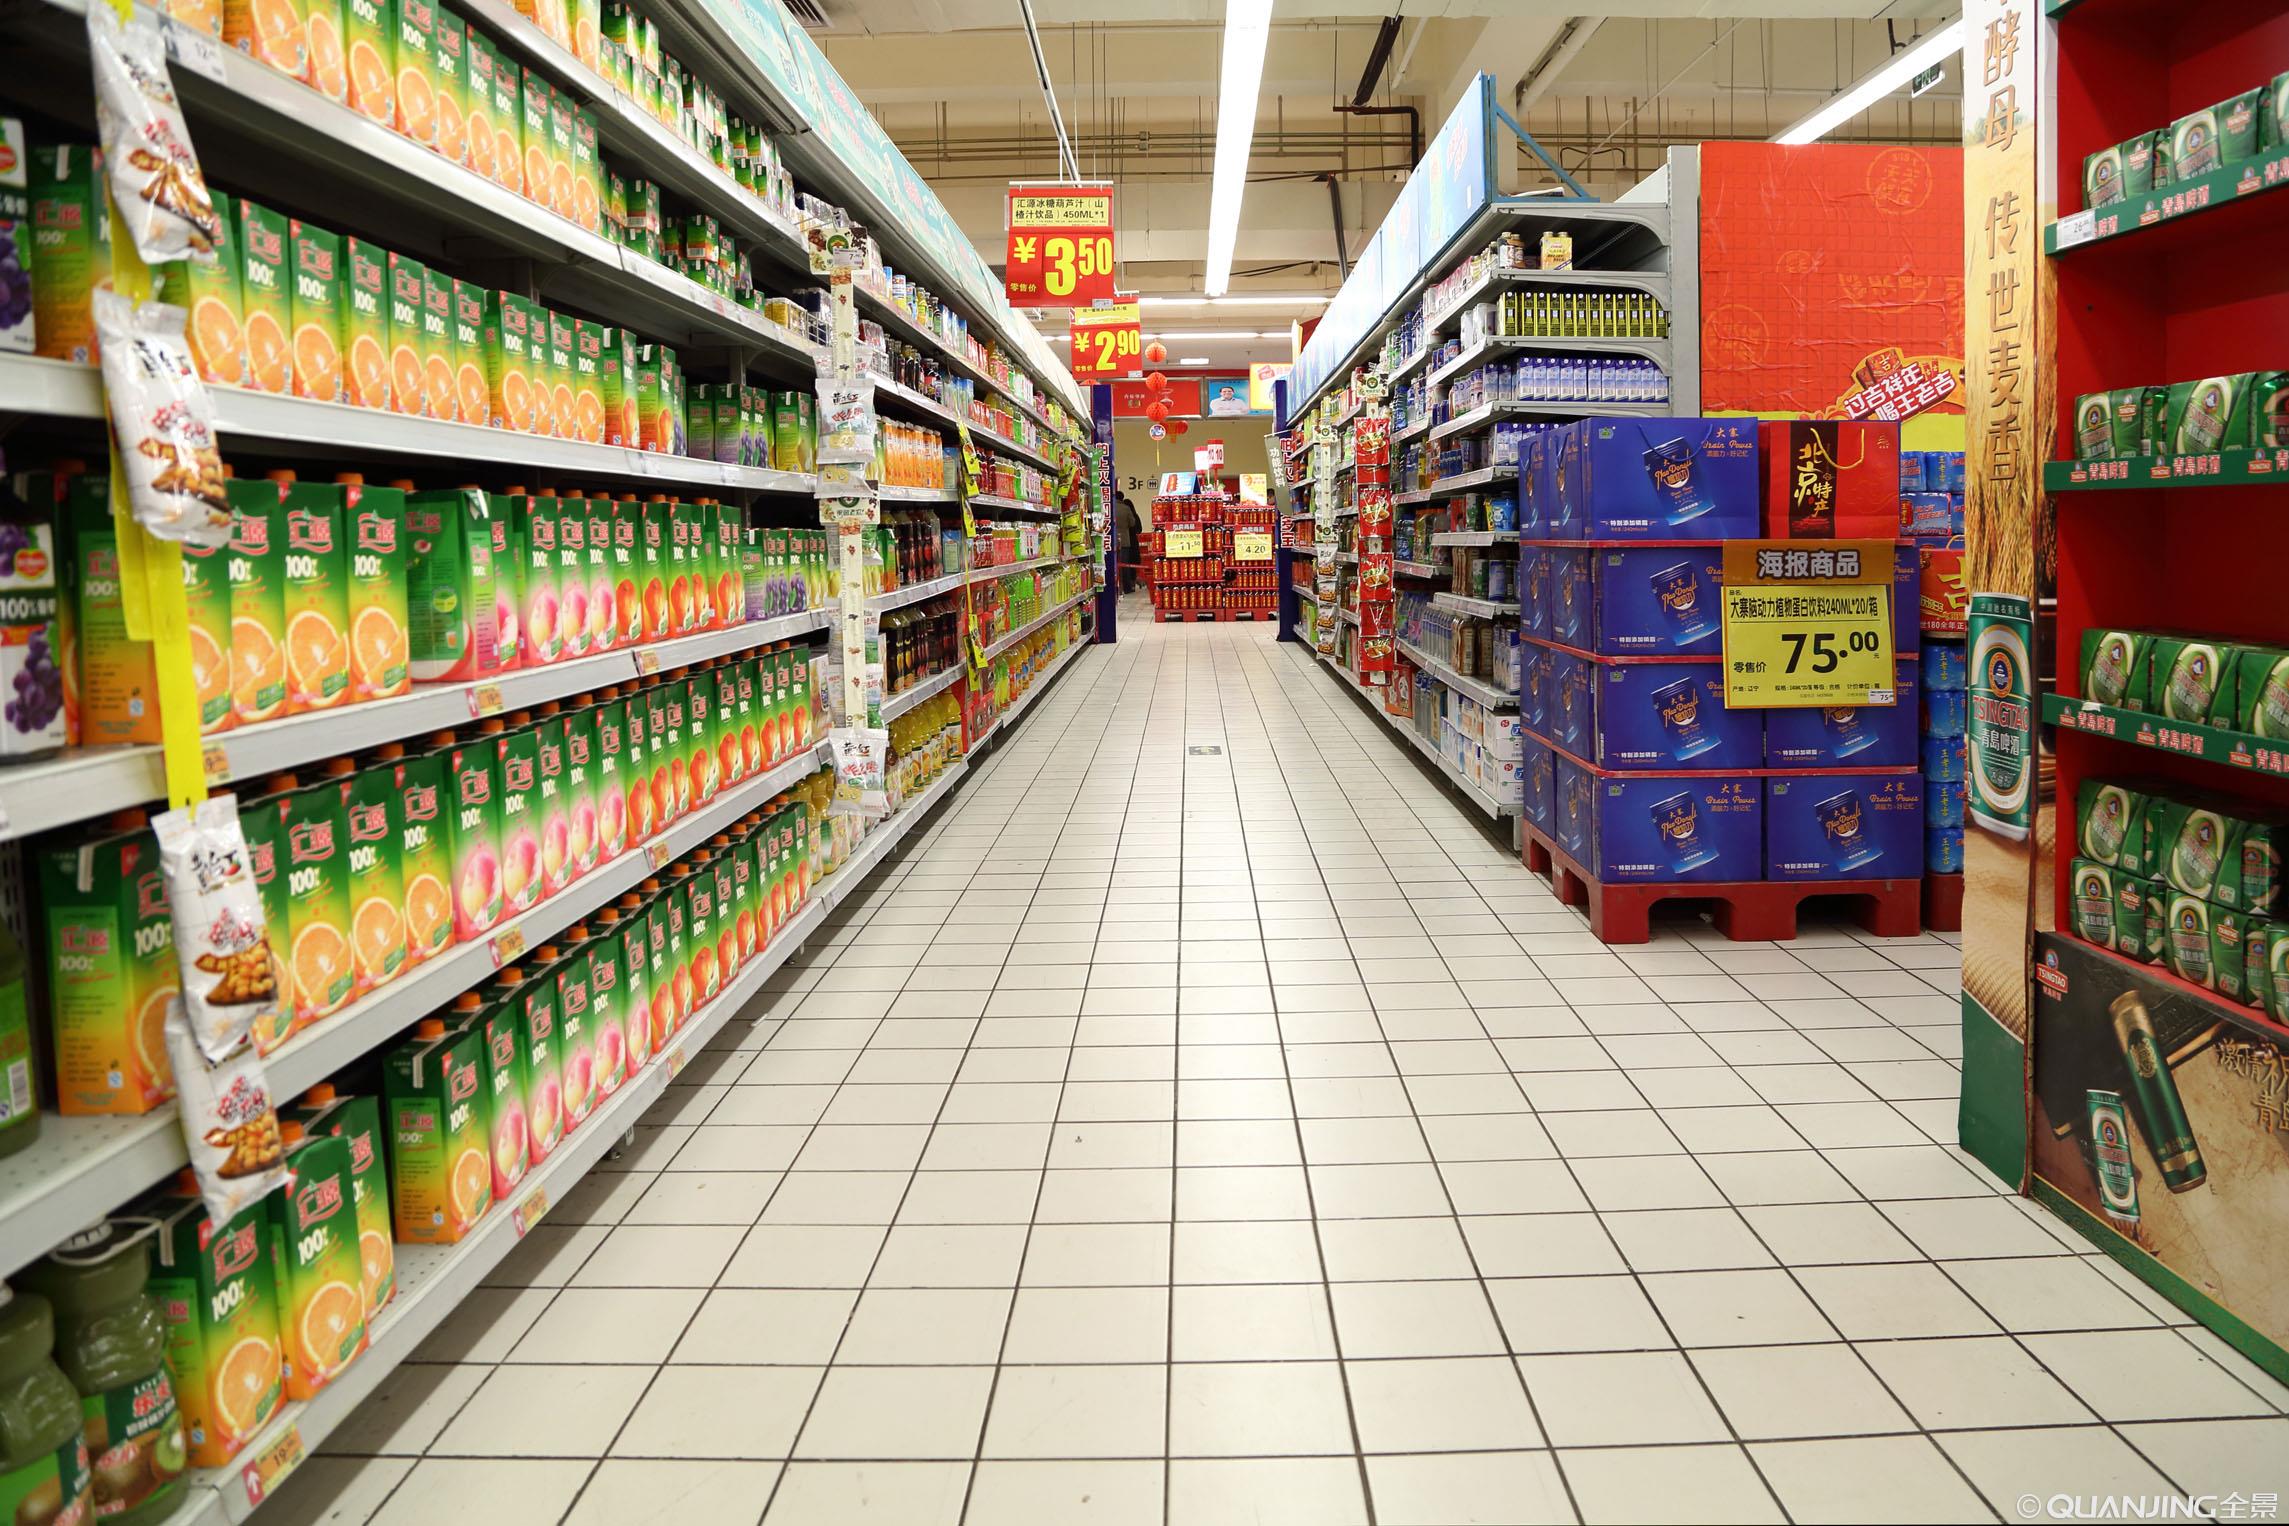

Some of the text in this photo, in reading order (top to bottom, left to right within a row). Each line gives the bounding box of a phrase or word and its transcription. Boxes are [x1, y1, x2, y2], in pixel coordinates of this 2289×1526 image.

[352, 0, 377, 24] 100%
[404, 0, 432, 34] 汇源
[402, 21, 426, 51] 100%
[437, 15, 461, 57] 汇源
[438, 49, 455, 75] 00%
[471, 39, 492, 79] 汇源
[1984, 0, 2022, 151] 酵母
[471, 68, 488, 96] 100%
[249, 221, 281, 264] 汇源
[2095, 214, 2119, 238] 啤酒
[299, 239, 333, 280] 汇源
[1013, 236, 1037, 263] ¥
[248, 259, 274, 286] 100%
[299, 275, 326, 301] 100%
[354, 255, 381, 293] 汇源
[395, 269, 421, 305] 汇源
[1010, 282, 1037, 293] 零售价
[354, 289, 376, 313] 100%
[394, 301, 415, 324] 100%
[503, 300, 527, 334] 汇源
[504, 332, 523, 351] 100%
[1075, 332, 1089, 352] ¥
[1985, 191, 2023, 481] 传世麦香
[1844, 362, 1925, 419] 过吉祥年
[1875, 370, 1956, 421] 喝王老吉
[1128, 476, 1144, 490] 3F
[1269, 447, 1286, 487] 功能饮料
[1794, 443, 1824, 507] 北京
[1812, 481, 1834, 518] 特产
[288, 510, 333, 554] 汇源
[358, 513, 396, 554] 汇源
[532, 515, 556, 550] 汇源
[286, 555, 318, 577] 100%
[354, 555, 380, 577] 100%
[532, 551, 548, 568] 100%
[1706, 566, 1724, 576] Bra
[1758, 550, 1860, 578] 海报商品
[1733, 661, 1767, 673] 零售价
[1781, 631, 1880, 674] 75.00
[1973, 695, 2030, 733] TSINGTAO
[460, 769, 490, 805] 汇源
[505, 757, 533, 791] 汇源
[404, 785, 438, 821] 汇源
[461, 808, 481, 830] 100%
[505, 794, 525, 815] 100%
[349, 803, 388, 843] 汇源
[404, 826, 428, 850] 100%
[289, 821, 335, 865] 汇源
[349, 846, 376, 874] 100%
[289, 868, 321, 897] 100%
[592, 959, 616, 993] 汇源
[2038, 967, 2066, 988] TSINGTAO
[593, 992, 609, 1015] 100%
[492, 1029, 514, 1070] 汇源
[451, 1062, 476, 1103] 汇源
[495, 1067, 510, 1095] 100%
[450, 1103, 470, 1132] 100%
[297, 1174, 343, 1231] 汇源
[213, 1221, 259, 1286] 汇源
[298, 1225, 329, 1265] 100%
[211, 1277, 246, 1321] 100%
